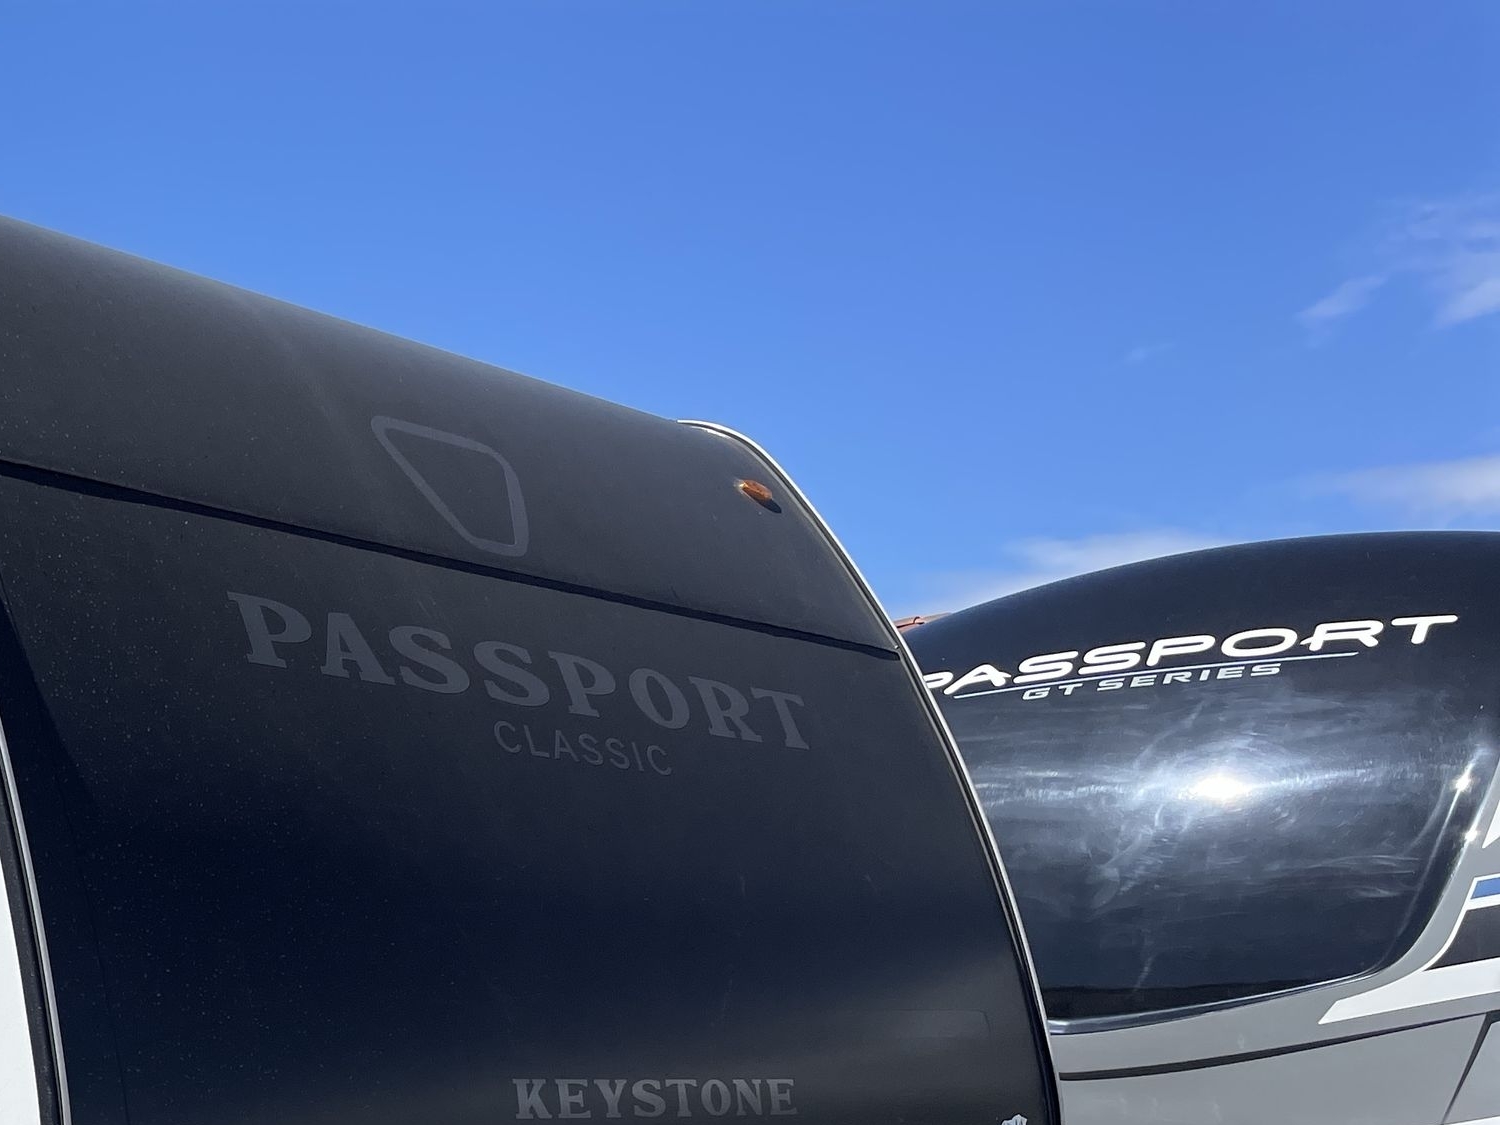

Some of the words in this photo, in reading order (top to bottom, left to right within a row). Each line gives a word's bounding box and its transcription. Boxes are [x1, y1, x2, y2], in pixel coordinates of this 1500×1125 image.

[227, 591, 811, 750] PASSPORT
[1023, 683, 1083, 700] GT
[1097, 663, 1281, 691] SERIES
[493, 720, 673, 776] CLASSIC
[512, 1078, 798, 1119] KEYSTONE
